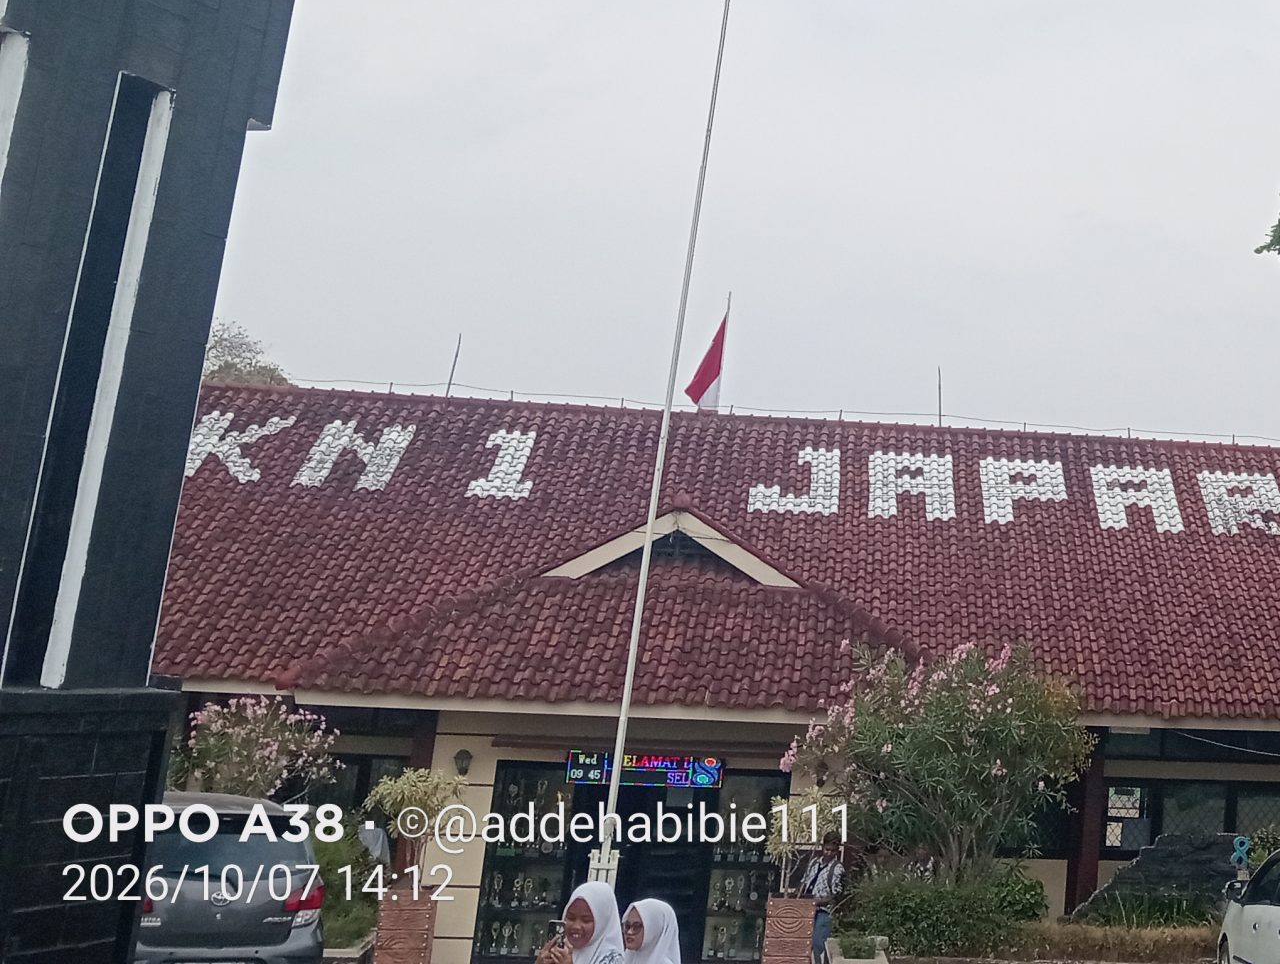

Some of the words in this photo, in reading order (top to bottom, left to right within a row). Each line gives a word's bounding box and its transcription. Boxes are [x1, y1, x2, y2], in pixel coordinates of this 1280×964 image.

[465, 429, 537, 500] 1
[578, 754, 597, 765] Wed
[622, 754, 679, 768] ELAMAT
